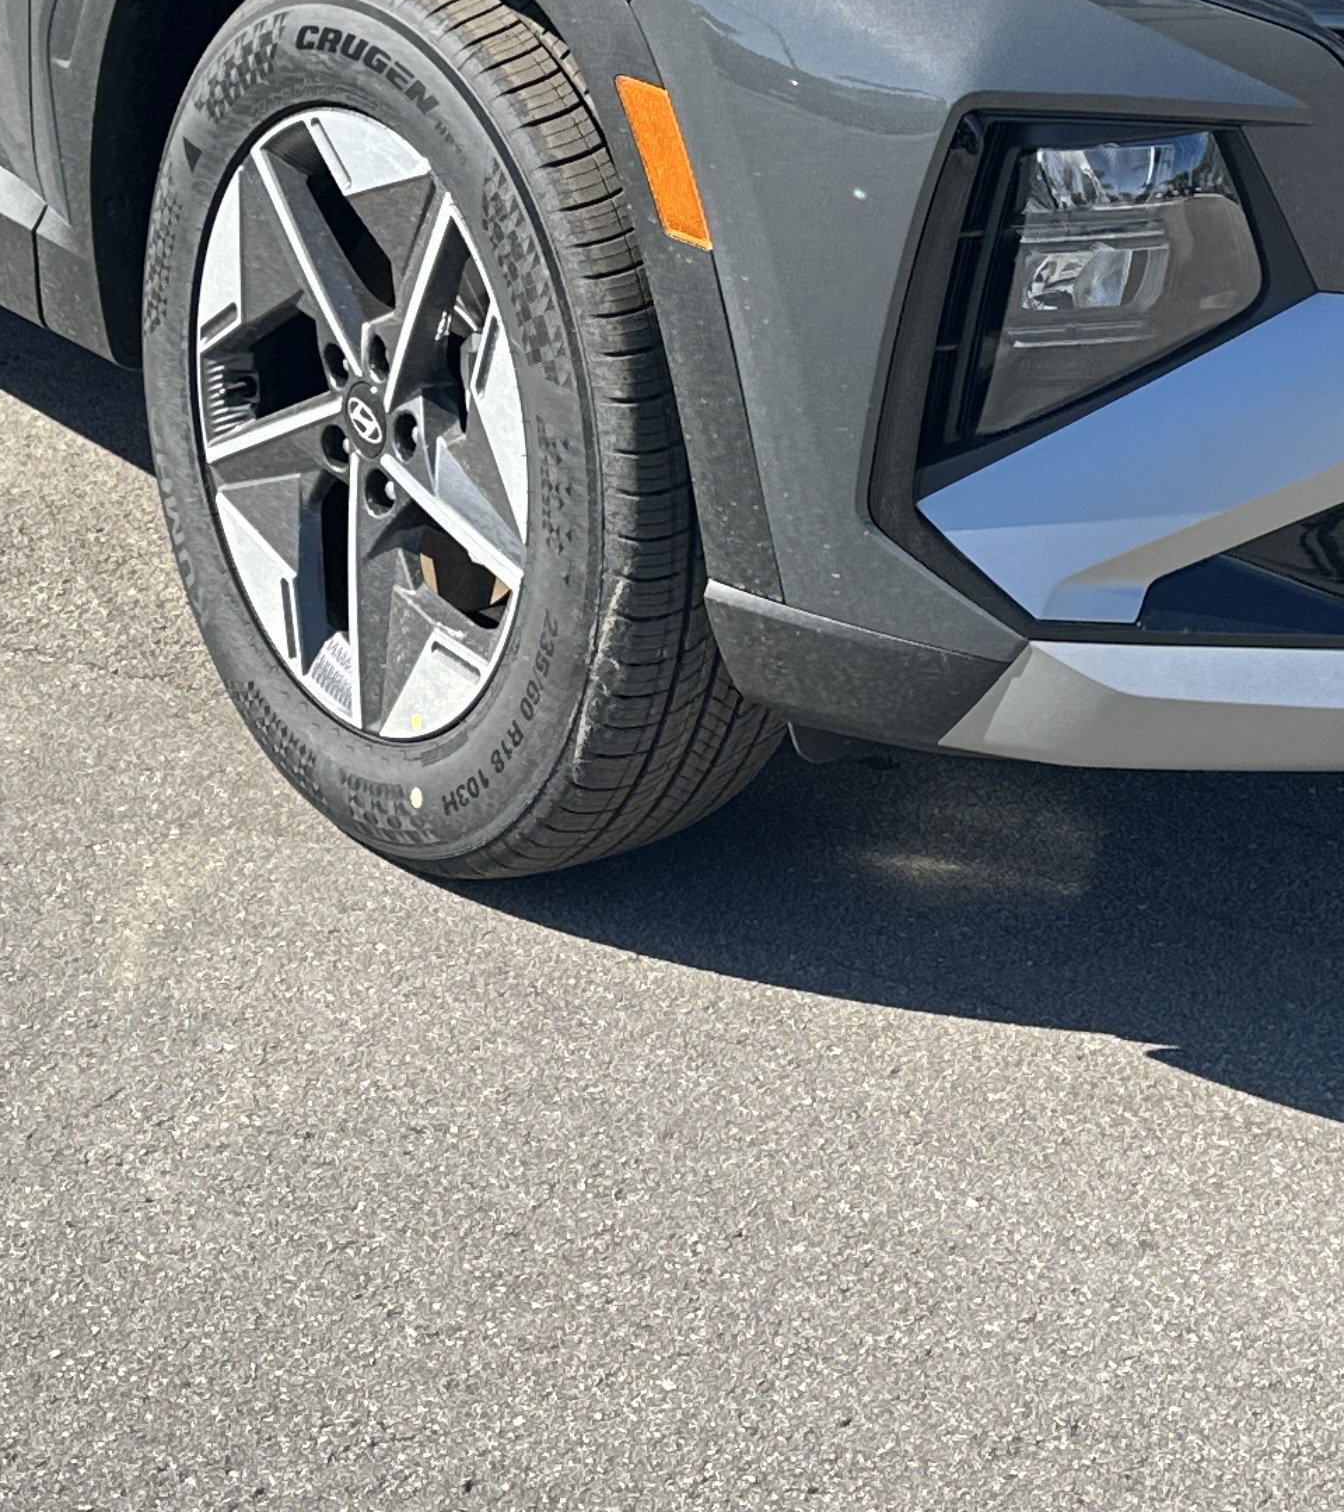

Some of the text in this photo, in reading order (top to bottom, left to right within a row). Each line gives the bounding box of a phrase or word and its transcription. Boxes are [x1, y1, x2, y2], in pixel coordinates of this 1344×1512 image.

[295, 24, 440, 116] CRUGEN
[440, 608, 559, 817] 235/60 R18 103H
